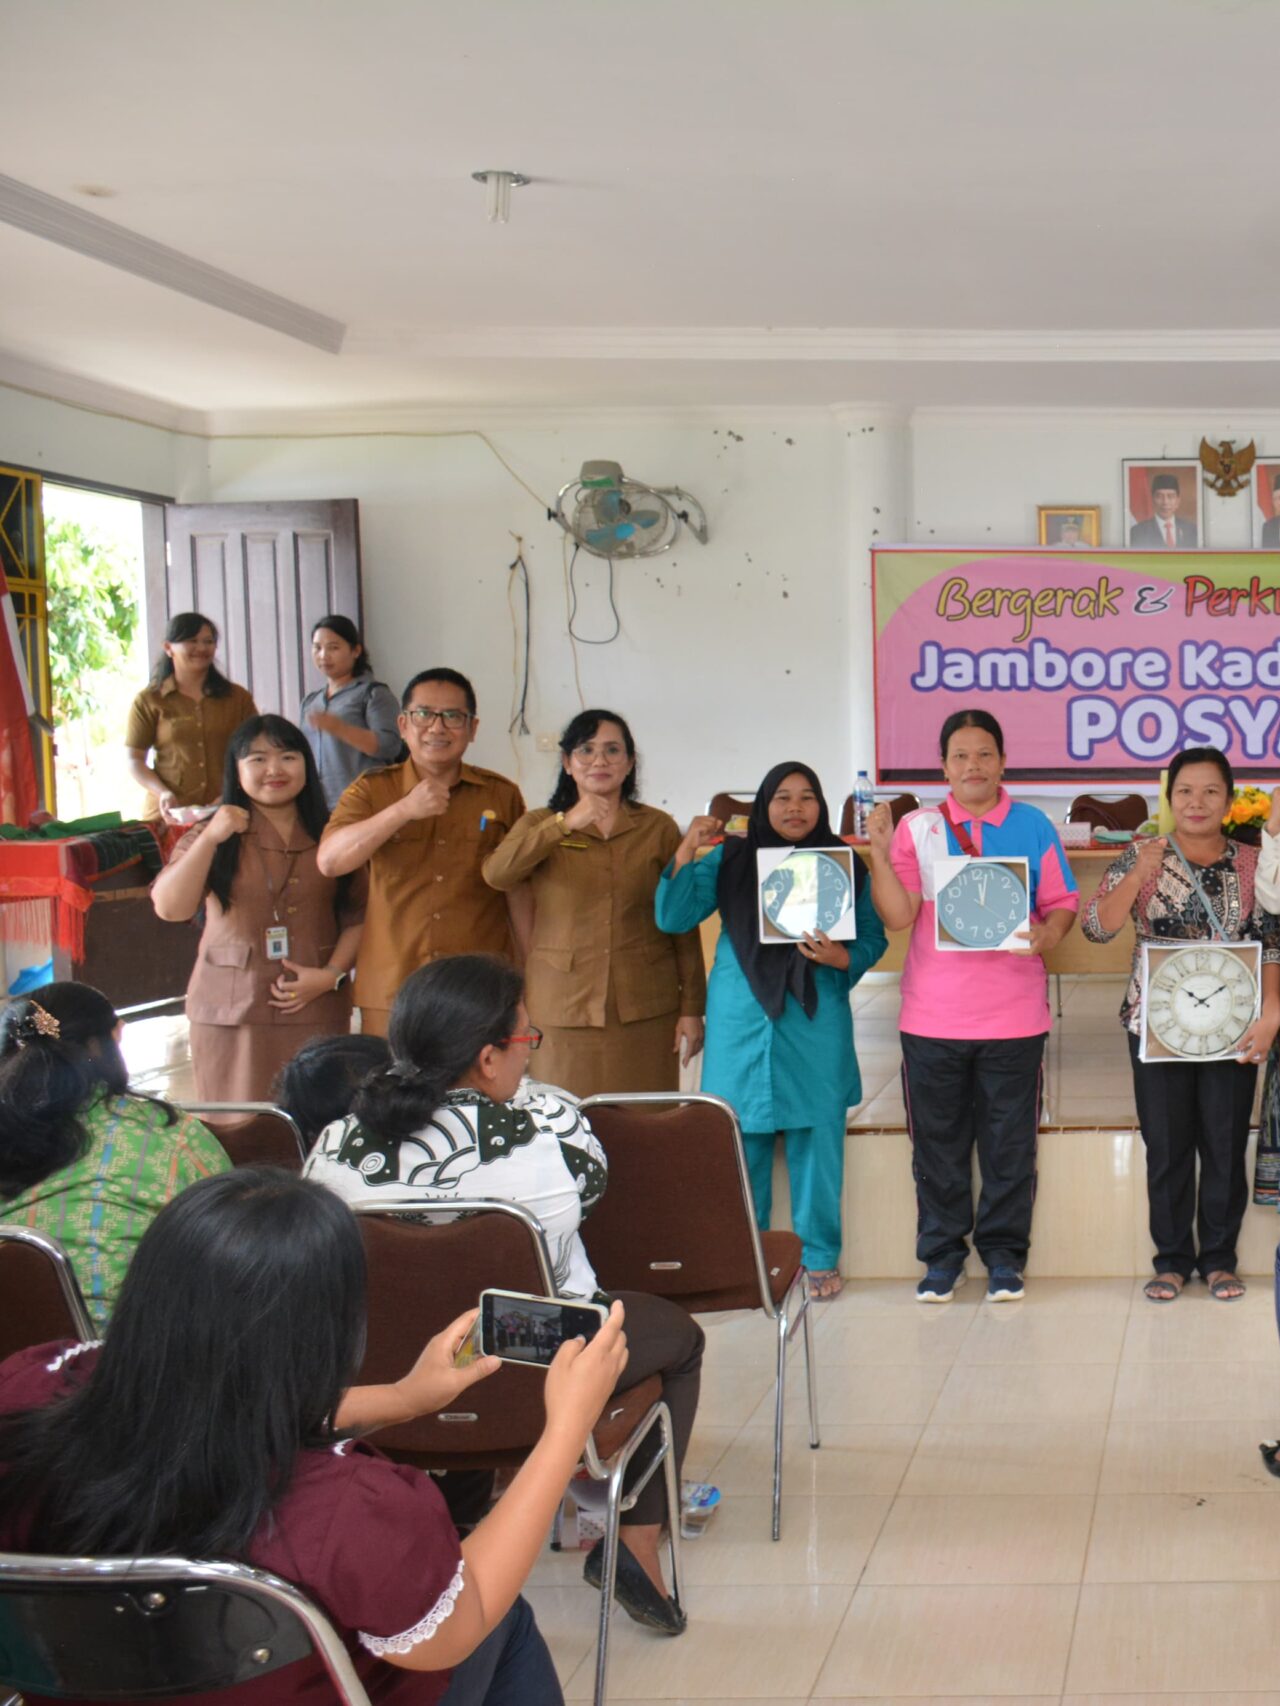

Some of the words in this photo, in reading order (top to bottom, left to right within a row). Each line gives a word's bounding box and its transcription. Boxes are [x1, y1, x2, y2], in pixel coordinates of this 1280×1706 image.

[936, 576, 1124, 643] Bergerak
[1133, 584, 1175, 617] &
[912, 637, 1169, 691] Jambore
[822, 864, 833, 876] 2
[971, 869, 983, 881] 12
[834, 878, 843, 891] 3
[958, 874, 967, 886] 11
[1001, 876, 1011, 889] 2
[948, 886, 962, 899] 10
[1011, 892, 1020, 904] 3
[834, 896, 843, 908] 4
[945, 903, 955, 915] 9
[1008, 909, 1017, 920] 4
[824, 911, 835, 923] 5
[955, 917, 964, 930] 8
[996, 921, 1007, 934] 5
[970, 926, 979, 938] 7
[984, 927, 994, 939] 6
